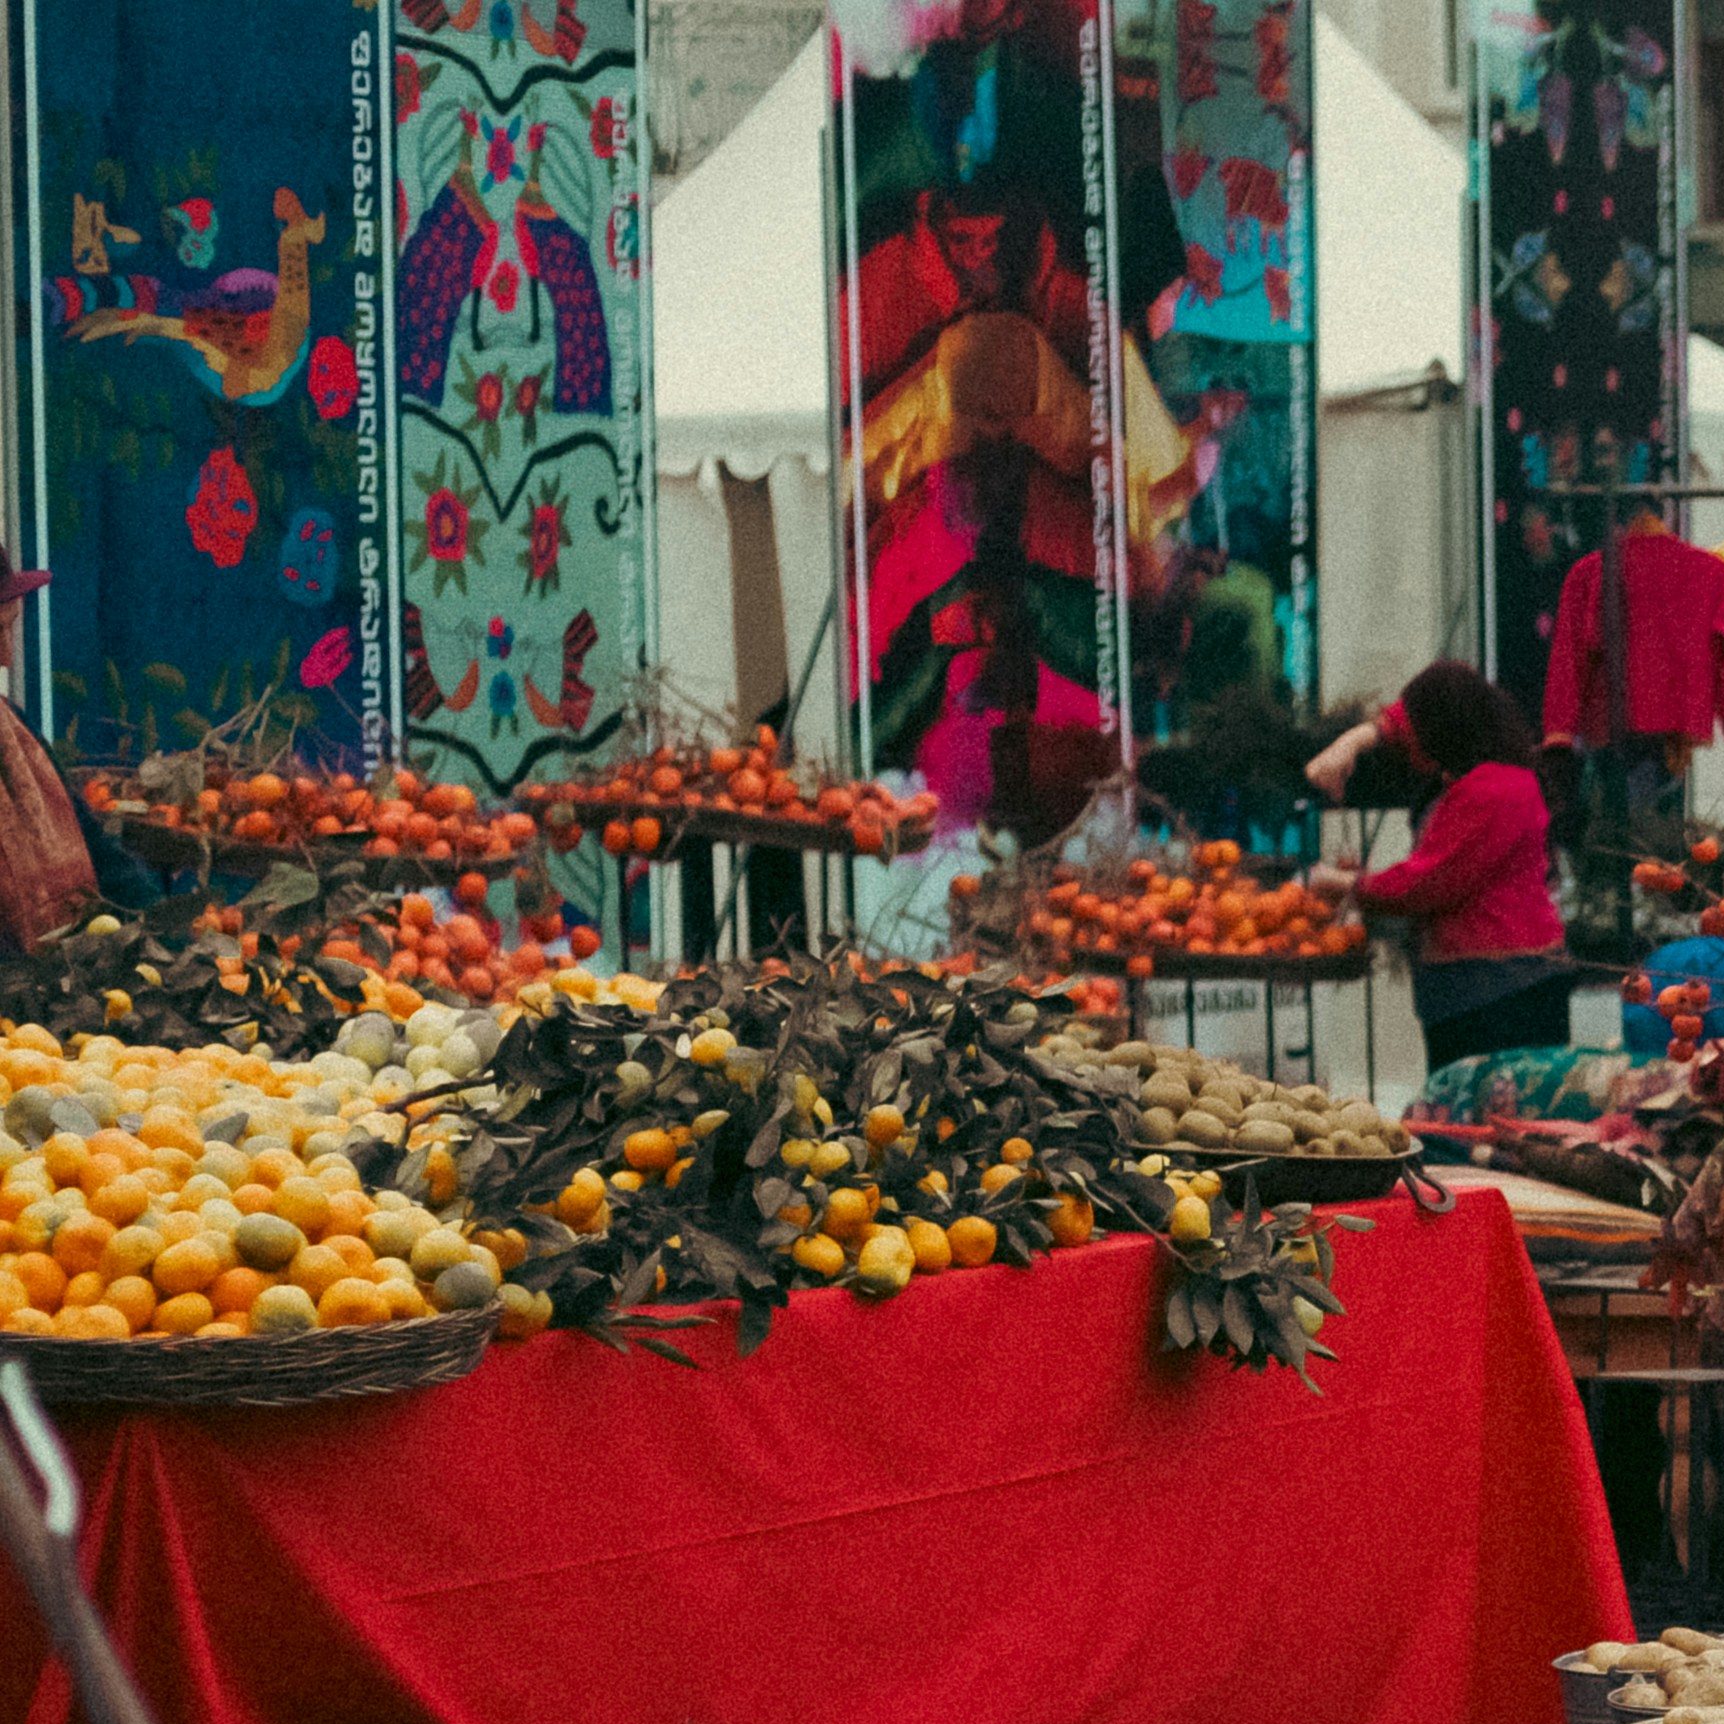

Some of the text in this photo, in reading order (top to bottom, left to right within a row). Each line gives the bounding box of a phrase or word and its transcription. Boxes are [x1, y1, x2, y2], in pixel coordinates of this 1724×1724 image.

[1078, 18, 1102, 217] ფერებად
[350, 29, 383, 782] ფერებად მოყოლილი ტრადიცი
